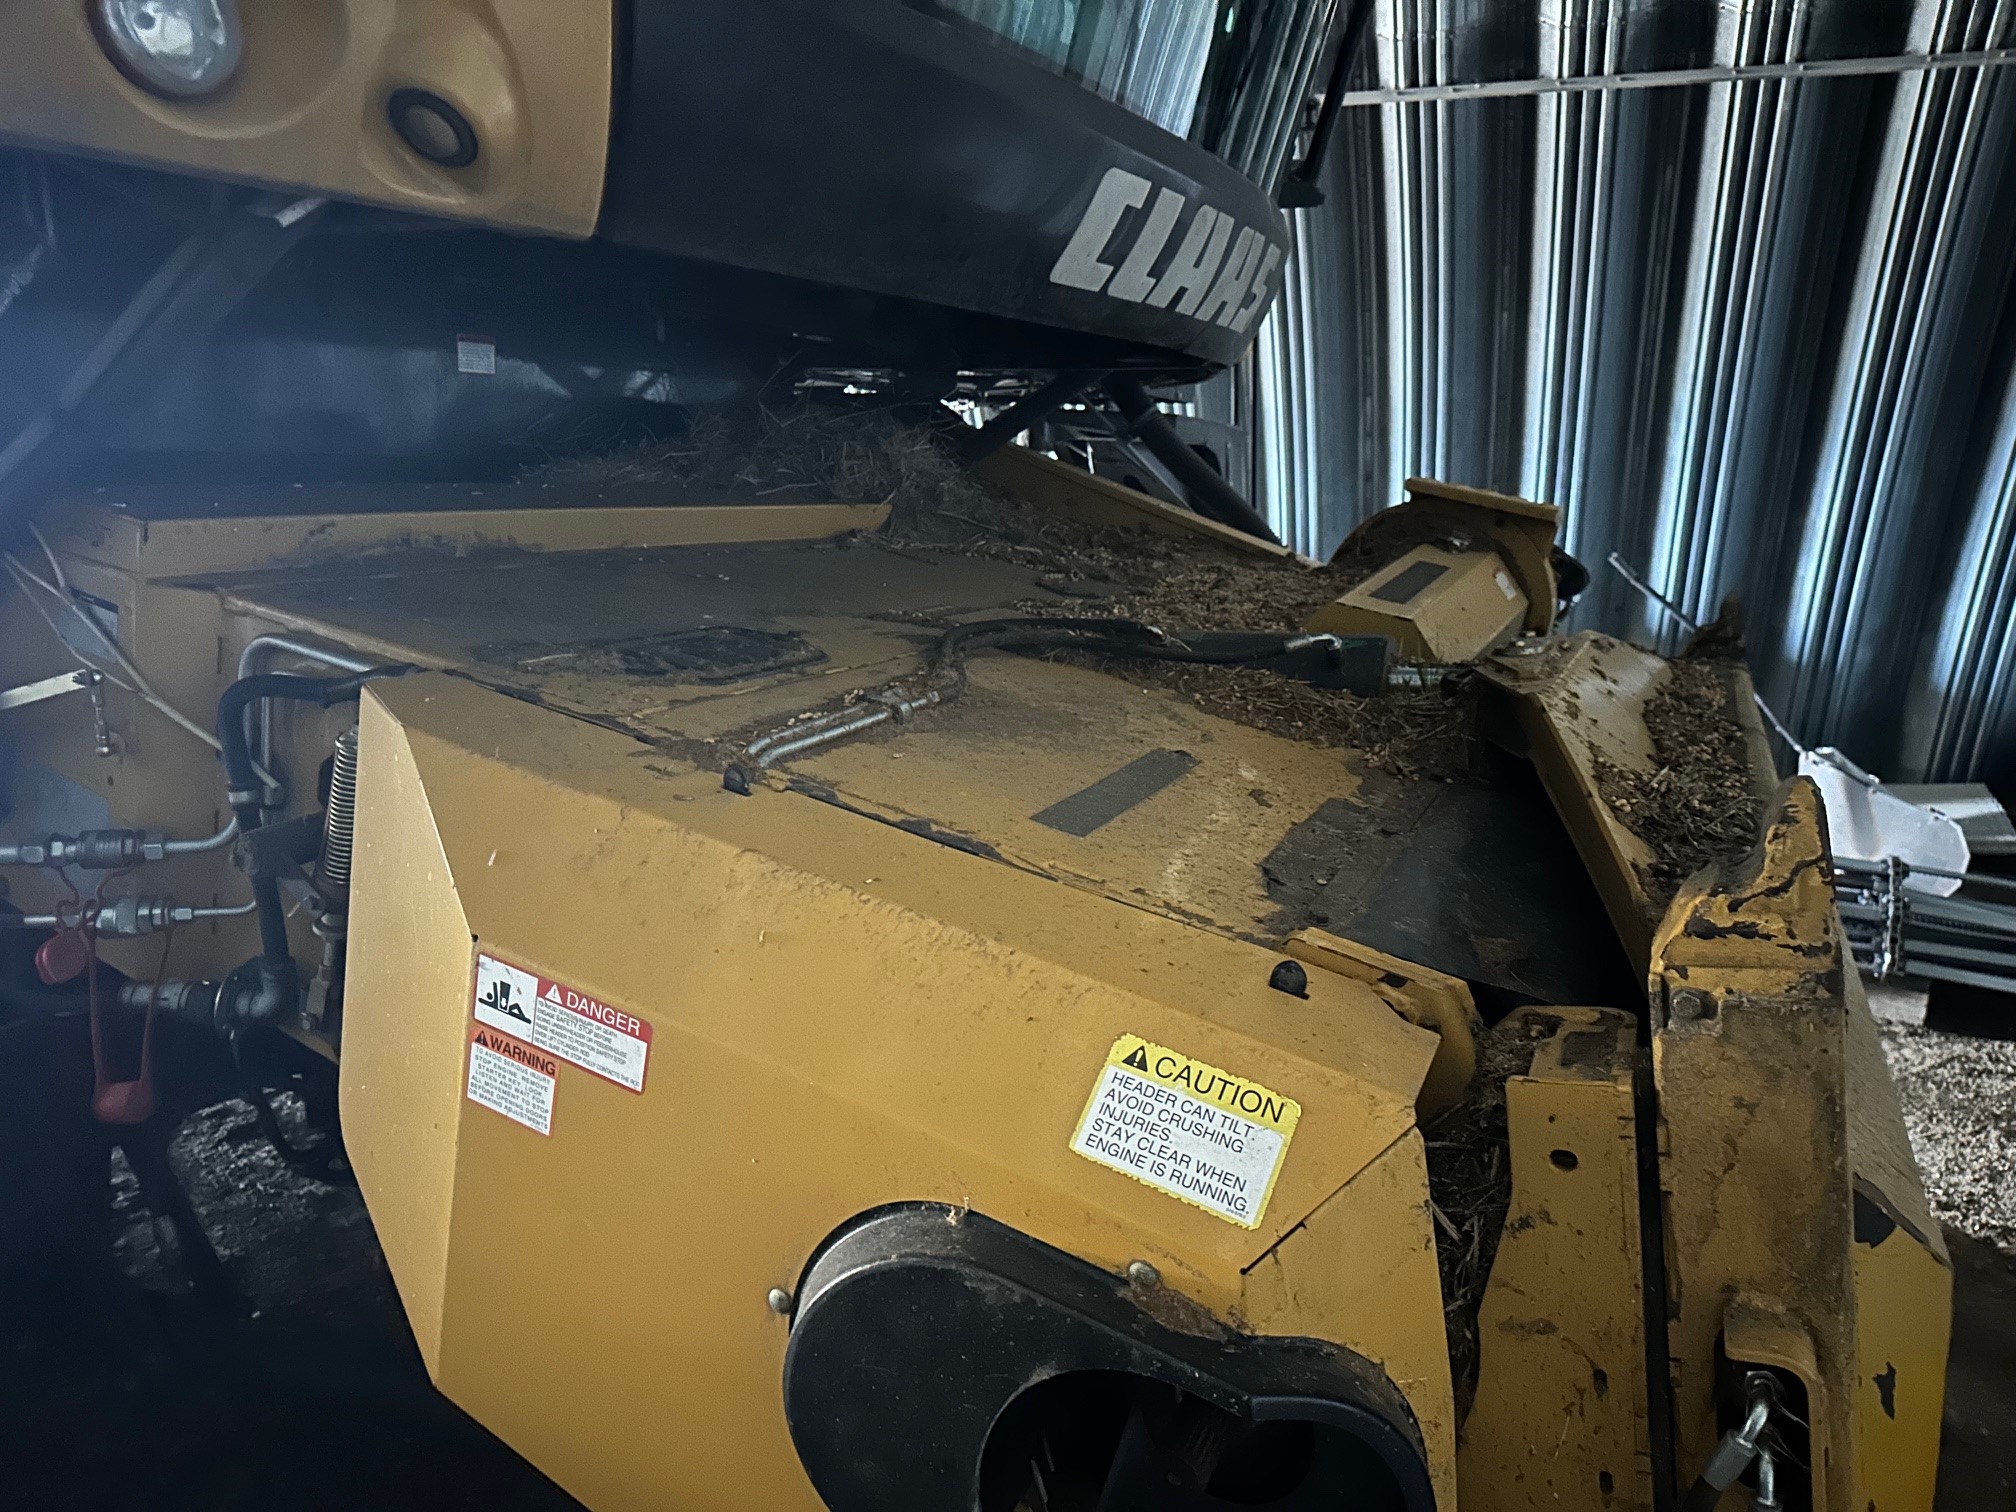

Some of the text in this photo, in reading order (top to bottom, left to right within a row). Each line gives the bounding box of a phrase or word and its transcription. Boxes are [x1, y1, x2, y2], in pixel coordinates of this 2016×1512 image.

[1049, 167, 1281, 333] CLAAS
[549, 1028, 567, 1040] HEADER
[556, 1014, 577, 1029] SAFETY
[578, 1024, 593, 1036] STOP
[566, 991, 640, 1036] DANGER
[474, 1054, 491, 1066] STOP
[521, 1075, 548, 1092] REMOVE
[476, 1046, 550, 1085] TO AVOID SERIOUS INJURY
[478, 1063, 506, 1080] STARTER
[490, 1034, 556, 1076] WARNING
[469, 1087, 477, 1096] OR
[479, 1092, 502, 1108] MAKING
[470, 1081, 547, 1122] BEFORE OPENING DOORS
[472, 1074, 548, 1115] ALL MOVEMENT TO STOP
[475, 1068, 545, 1105] LISTEN AND WAIT FOR
[1111, 1071, 1177, 1107] HEADER
[1179, 1099, 1216, 1123] CAN
[1155, 1057, 1285, 1123] CAUTION
[1098, 1101, 1175, 1144] INJURIES.
[1104, 1086, 1245, 1154] AVOID CRUSHING
[1085, 1132, 1252, 1215] ENGINE IS RUNNING.
[1092, 1117, 1247, 1193] STAY CLEAR WHEN
